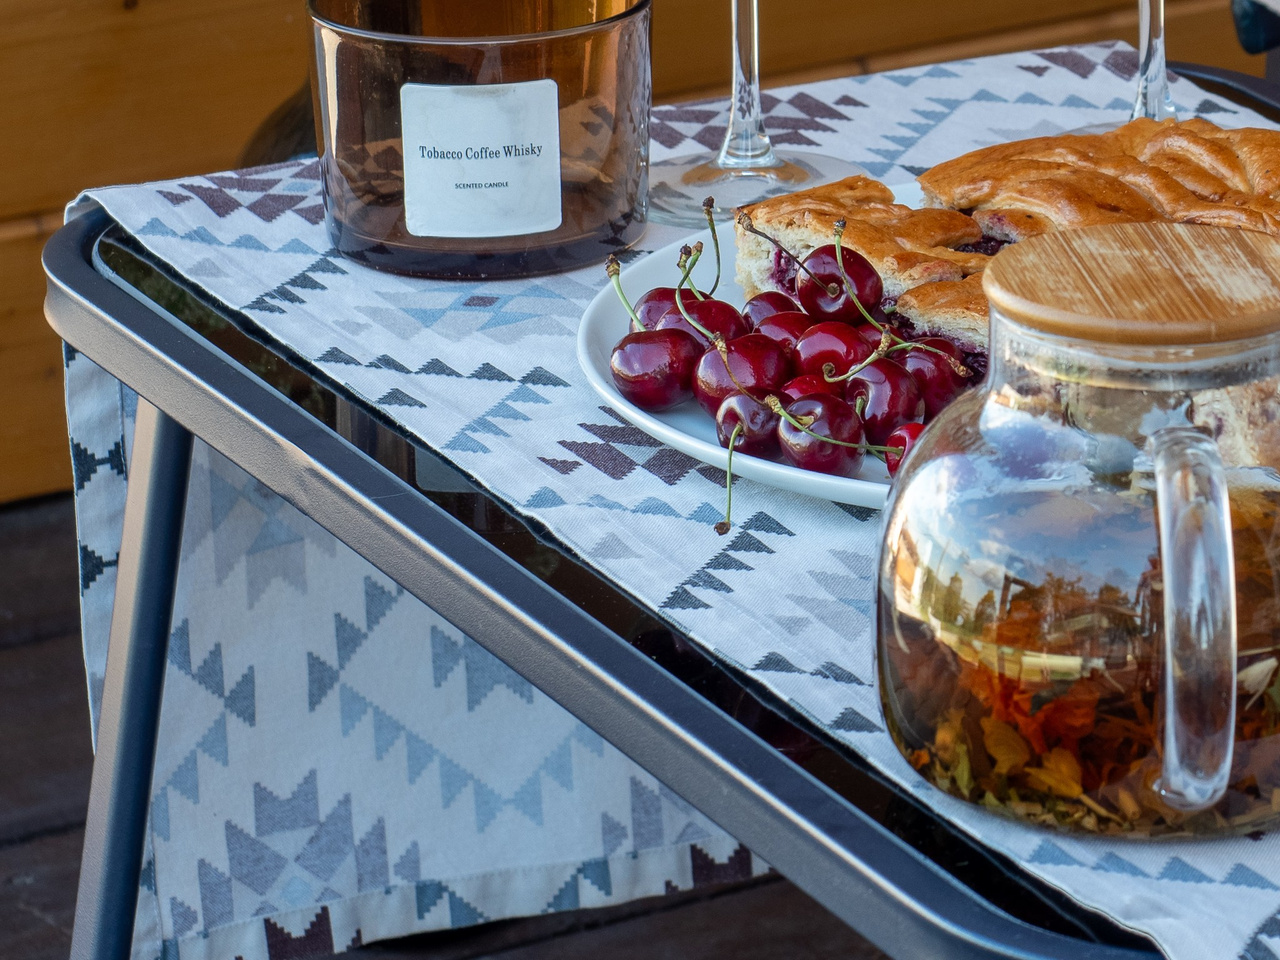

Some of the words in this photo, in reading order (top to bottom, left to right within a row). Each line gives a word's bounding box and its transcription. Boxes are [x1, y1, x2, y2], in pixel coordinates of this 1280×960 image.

[419, 145, 463, 160] Tobacco
[465, 147, 501, 160] Coffee
[503, 143, 543, 158] Whisky
[484, 181, 509, 189] CANDLE
